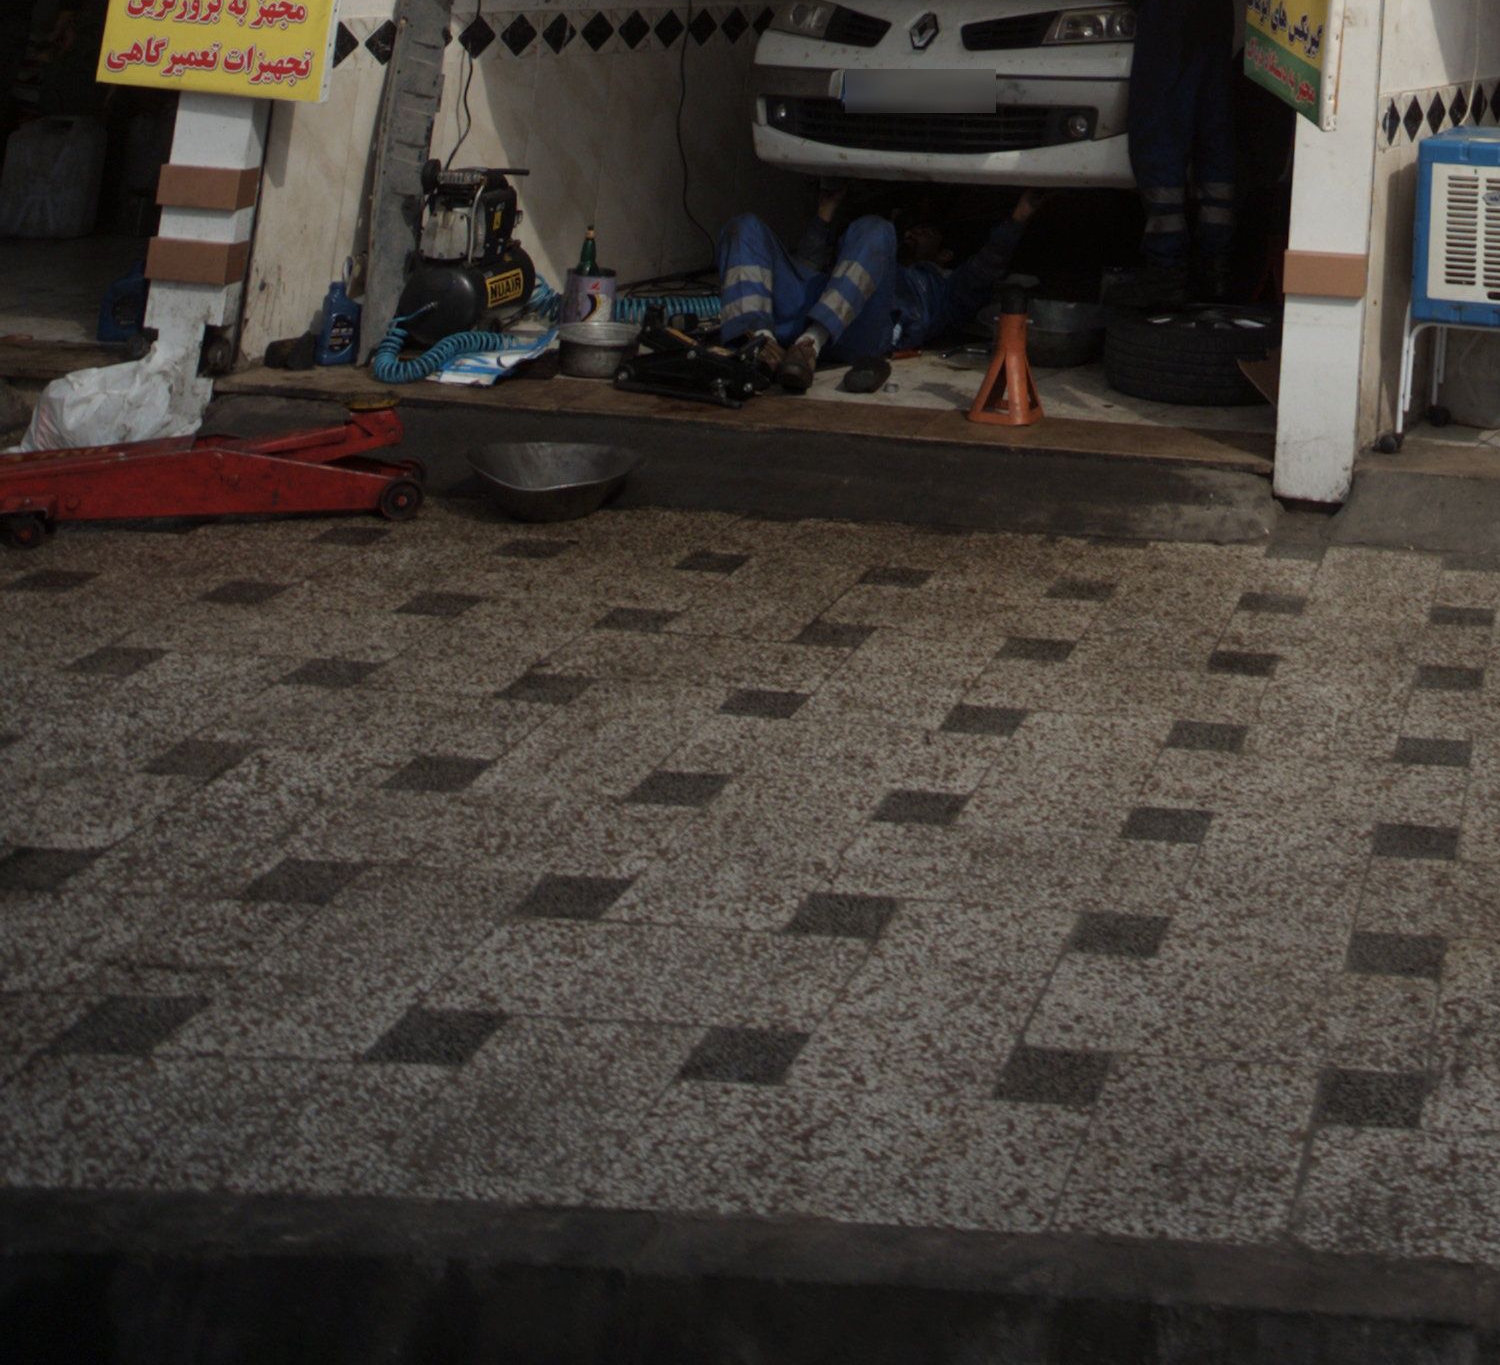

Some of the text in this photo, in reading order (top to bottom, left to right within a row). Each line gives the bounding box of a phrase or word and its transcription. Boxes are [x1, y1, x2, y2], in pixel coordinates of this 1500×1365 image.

[1288, 13, 1323, 59] گیربکس
[223, 45, 312, 86] تجهیزات
[490, 277, 521, 299] NUAIR
